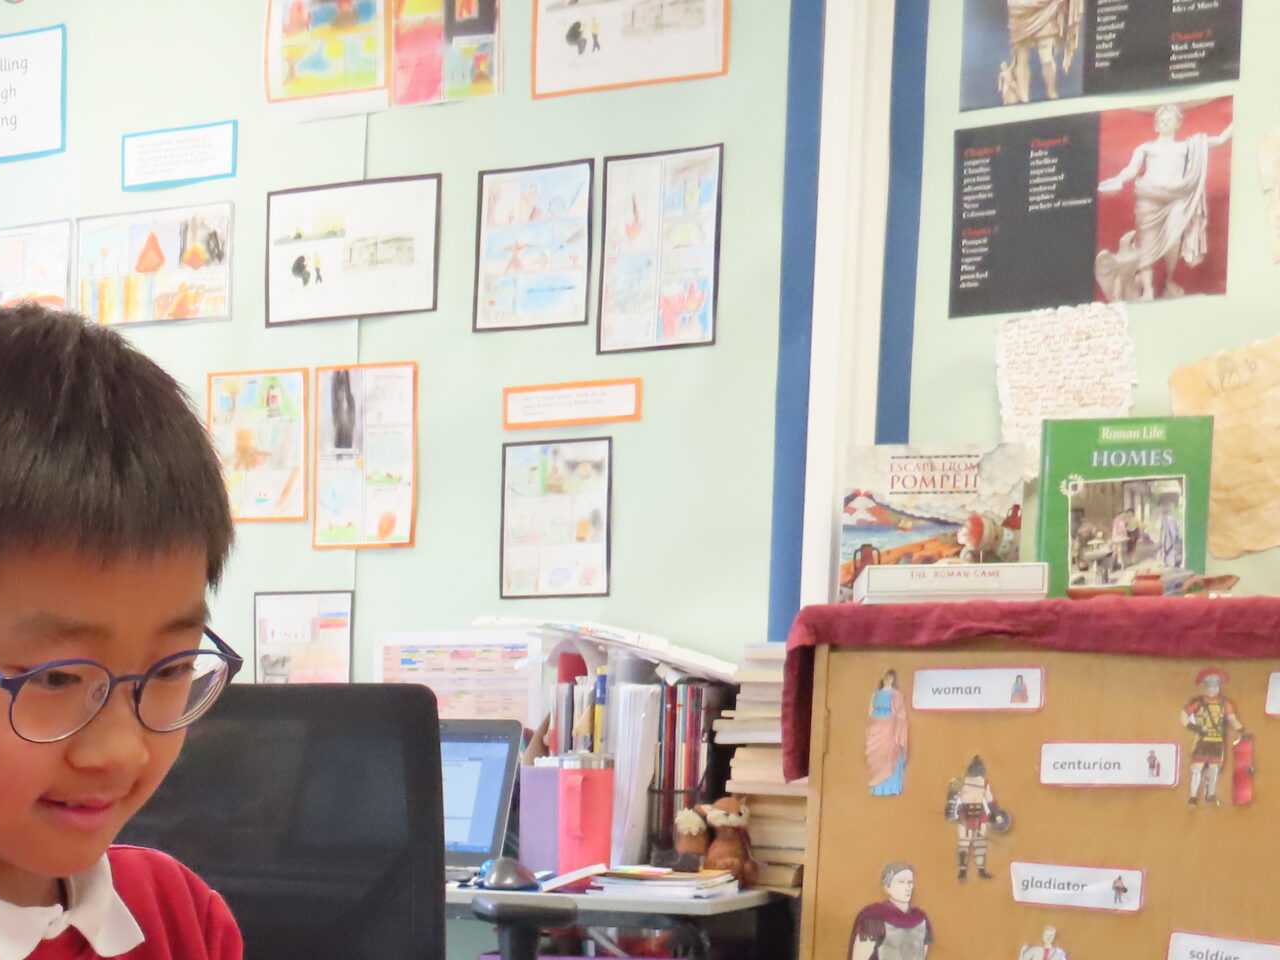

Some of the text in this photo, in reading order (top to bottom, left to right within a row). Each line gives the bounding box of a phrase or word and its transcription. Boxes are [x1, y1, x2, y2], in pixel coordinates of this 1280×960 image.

[1102, 424, 1164, 440] Roman Life
[1091, 448, 1175, 467] HOMES
[890, 461, 980, 473] ESCAPE FROM
[891, 473, 978, 489] POMPEII
[933, 569, 969, 579] ROMAN
[973, 569, 1000, 578] GAME
[931, 684, 982, 697] woman
[1052, 757, 1122, 772] centurion
[1021, 876, 1088, 894] gladiator
